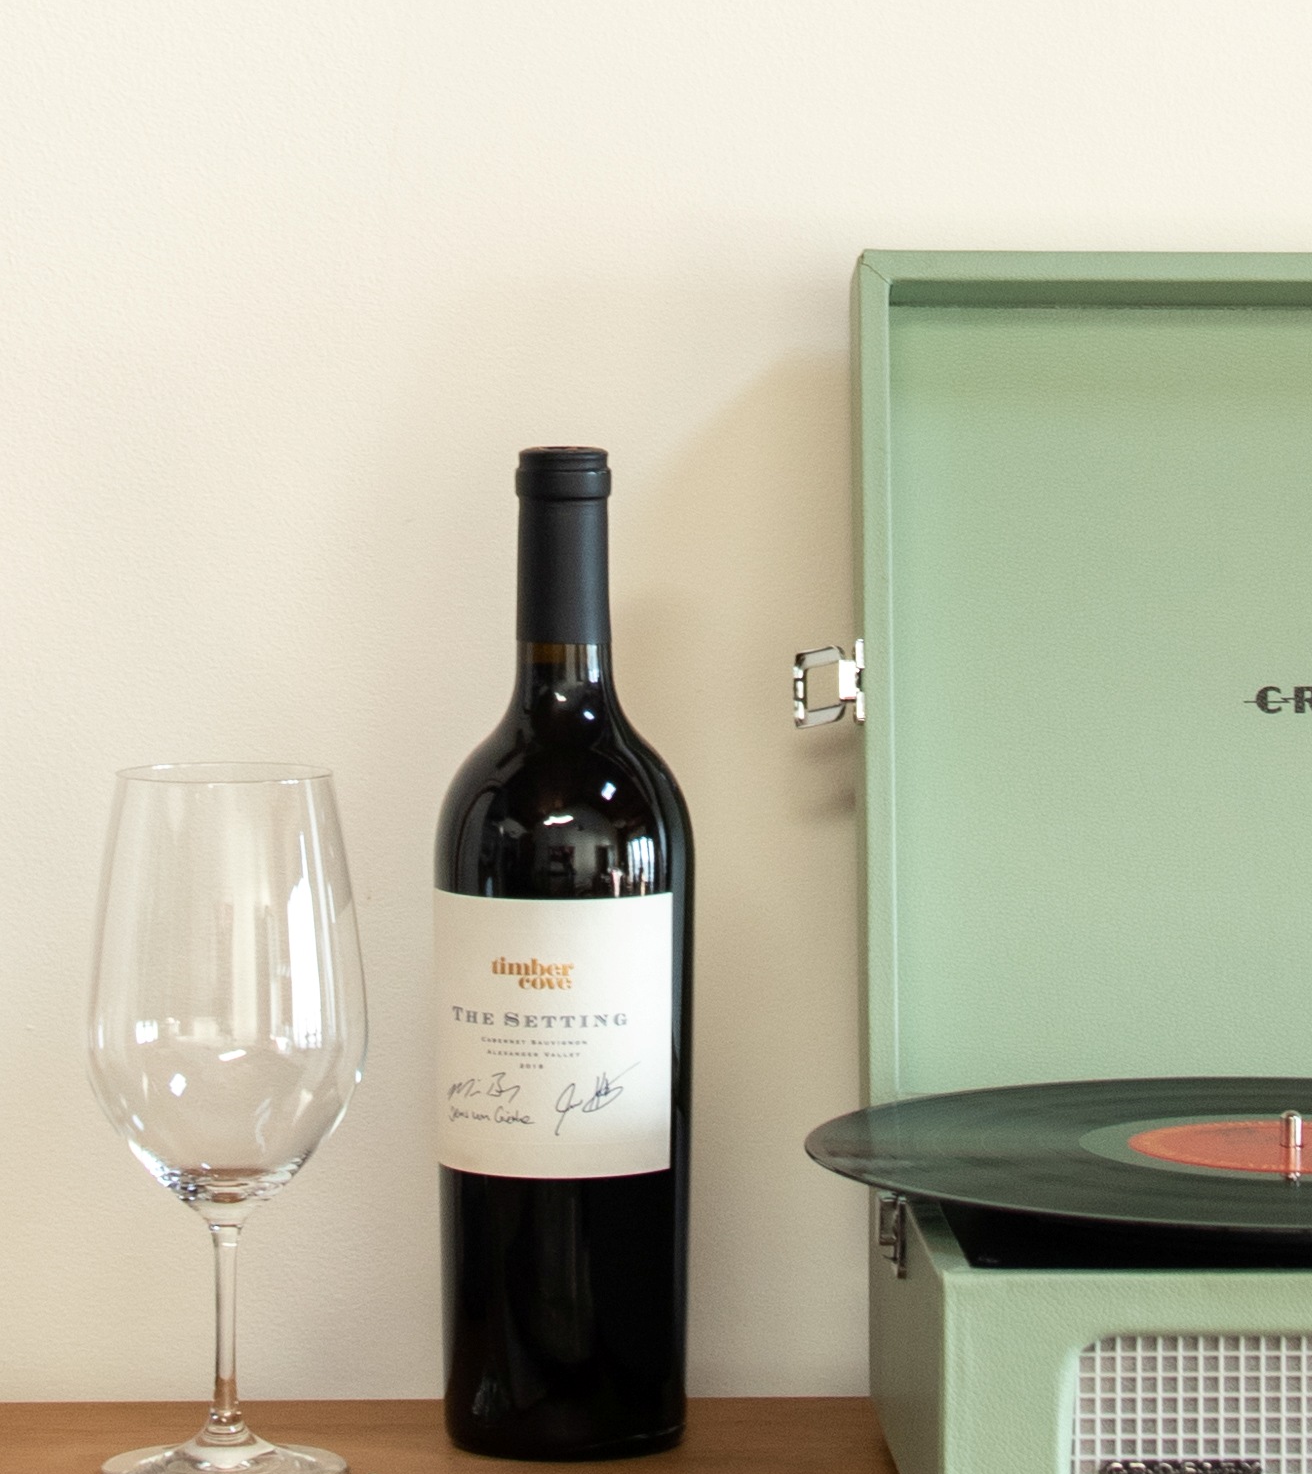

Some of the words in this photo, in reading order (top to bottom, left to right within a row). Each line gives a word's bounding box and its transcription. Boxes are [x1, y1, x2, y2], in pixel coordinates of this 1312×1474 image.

[491, 956, 575, 977] timber
[518, 976, 573, 991] cove
[452, 1005, 495, 1026] THE
[504, 1012, 628, 1029] SETTING
